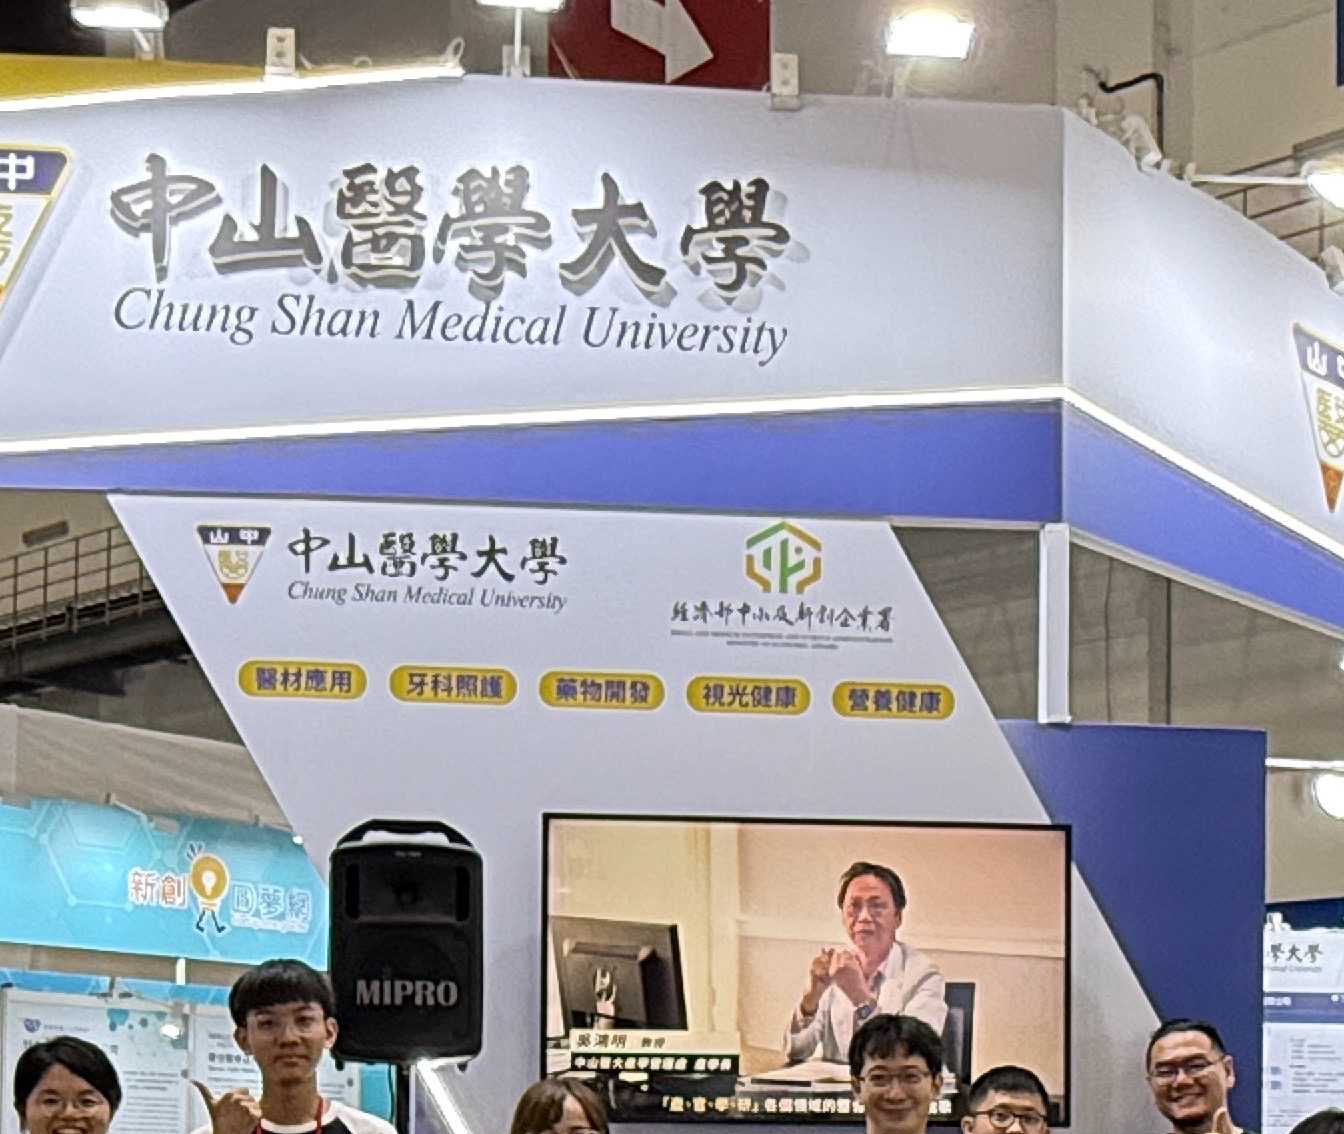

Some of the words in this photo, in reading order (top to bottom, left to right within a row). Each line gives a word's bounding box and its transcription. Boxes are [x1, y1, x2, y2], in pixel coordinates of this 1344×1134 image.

[109, 152, 789, 306] 中山醫學大學
[113, 286, 258, 347] Chung
[271, 293, 380, 339] Shan
[397, 299, 565, 347] Medical
[579, 306, 788, 368] University
[286, 527, 568, 583] 中山醫學大學
[288, 580, 344, 607] Chung
[351, 583, 397, 604] Shan
[403, 586, 474, 607] Medical
[480, 589, 568, 614] University
[255, 667, 353, 696] 醫材應用
[406, 673, 505, 701] 牙科照護
[555, 676, 652, 707] 藥物開發
[702, 682, 798, 711] 視光健康
[849, 687, 944, 716] 營養健康
